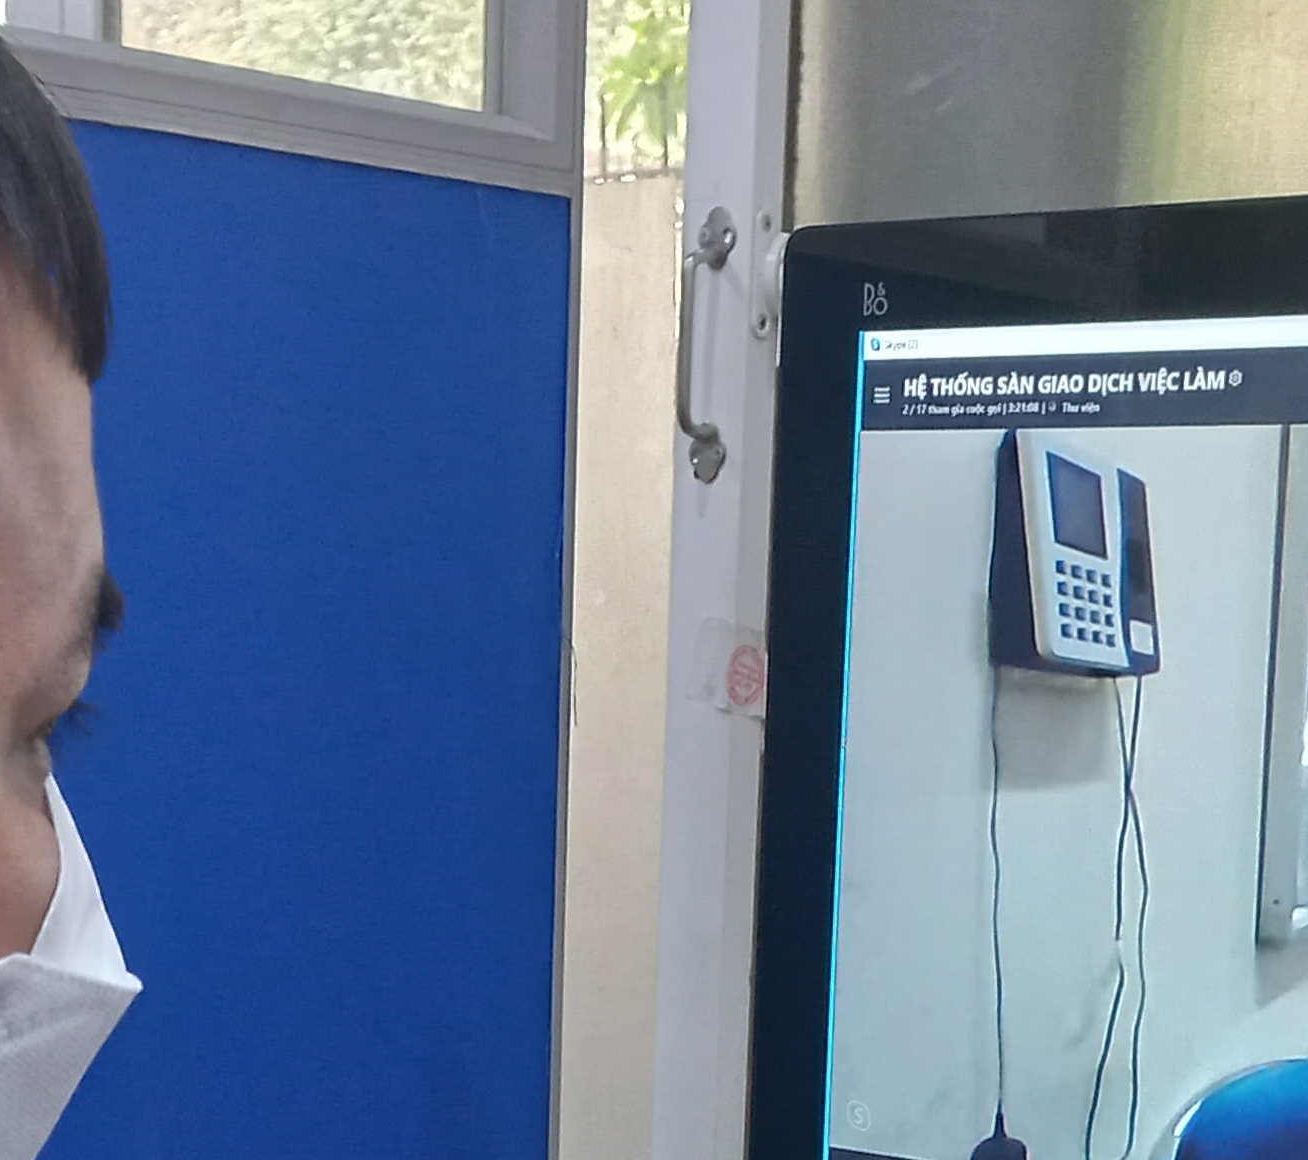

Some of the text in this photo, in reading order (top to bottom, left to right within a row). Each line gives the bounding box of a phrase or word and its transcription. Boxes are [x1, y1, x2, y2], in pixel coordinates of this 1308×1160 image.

[903, 365, 1226, 401] HỆ THỐNG SÀN GIAO DỊCH VIỆC LÀM
[917, 403, 927, 415] 17
